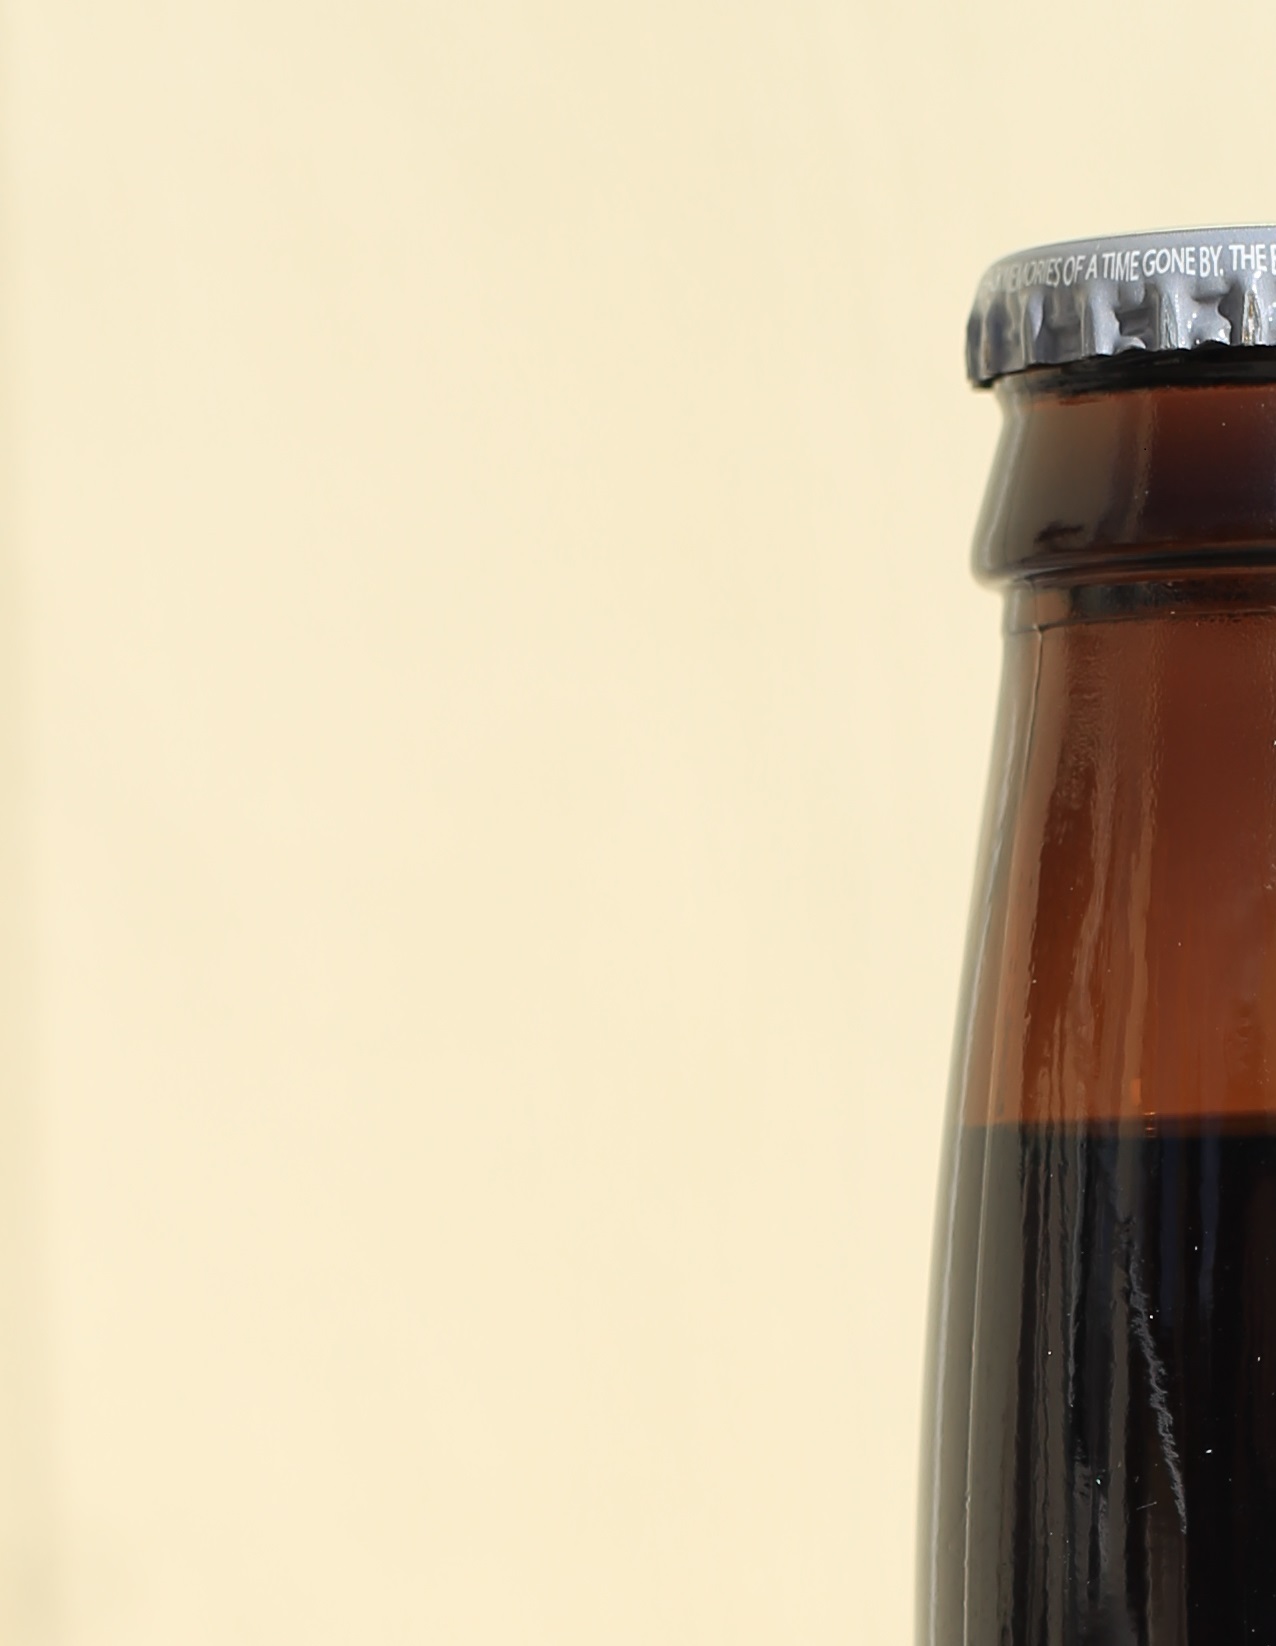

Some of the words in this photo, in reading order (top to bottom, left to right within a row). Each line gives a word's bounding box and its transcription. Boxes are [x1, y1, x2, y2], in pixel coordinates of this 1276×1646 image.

[1063, 255, 1086, 287] OF
[1085, 254, 1098, 281] A
[1102, 250, 1141, 283] TIME
[1142, 246, 1196, 278] GONE
[1199, 245, 1225, 278] BY.
[1228, 243, 1268, 273] THE
